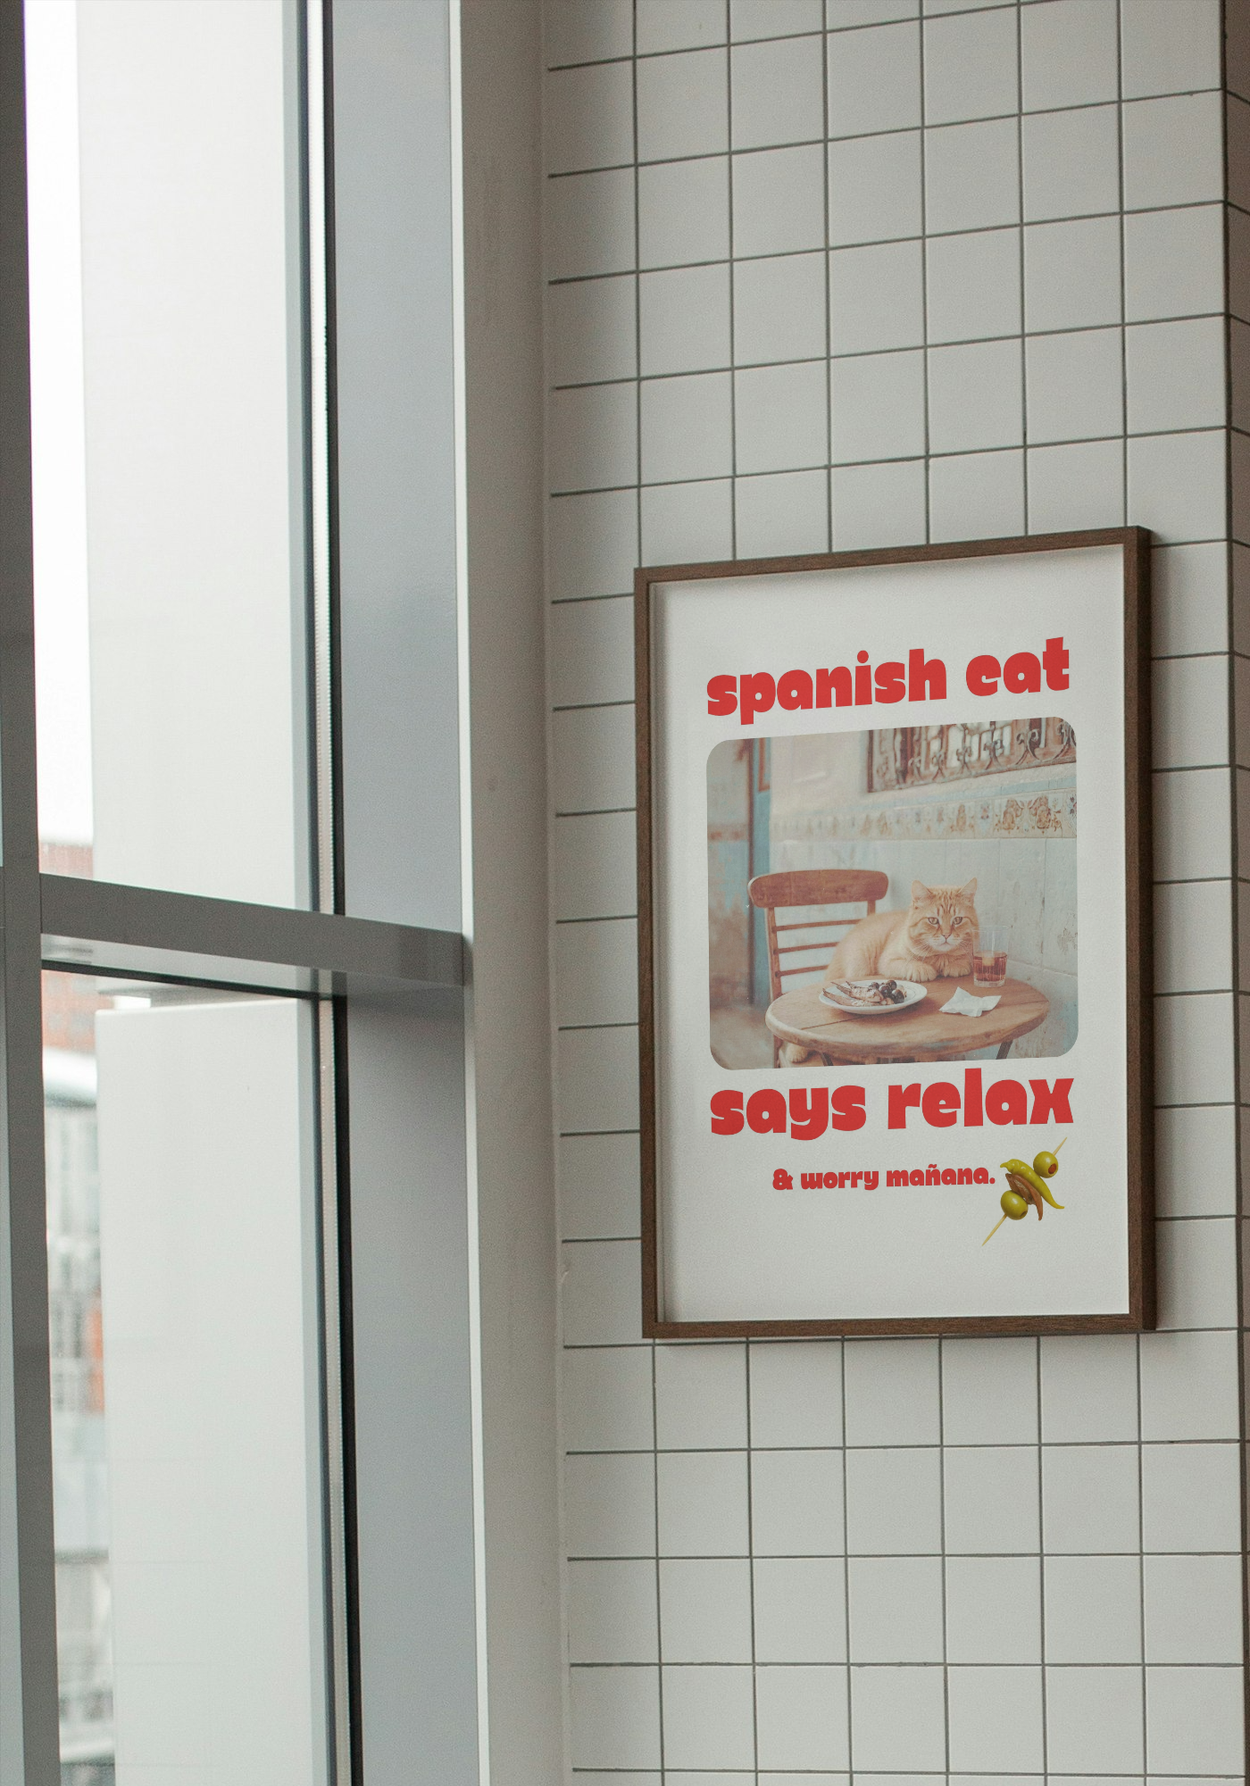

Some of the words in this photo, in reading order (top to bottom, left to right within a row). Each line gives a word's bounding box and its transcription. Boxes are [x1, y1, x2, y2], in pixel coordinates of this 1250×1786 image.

[706, 648, 947, 726] spanish
[965, 636, 1070, 697] cat
[710, 1085, 867, 1141] says
[887, 1067, 1074, 1130] relax
[772, 1168, 794, 1191] &
[800, 1170, 879, 1191] worry
[886, 1163, 996, 1188] mañana.
